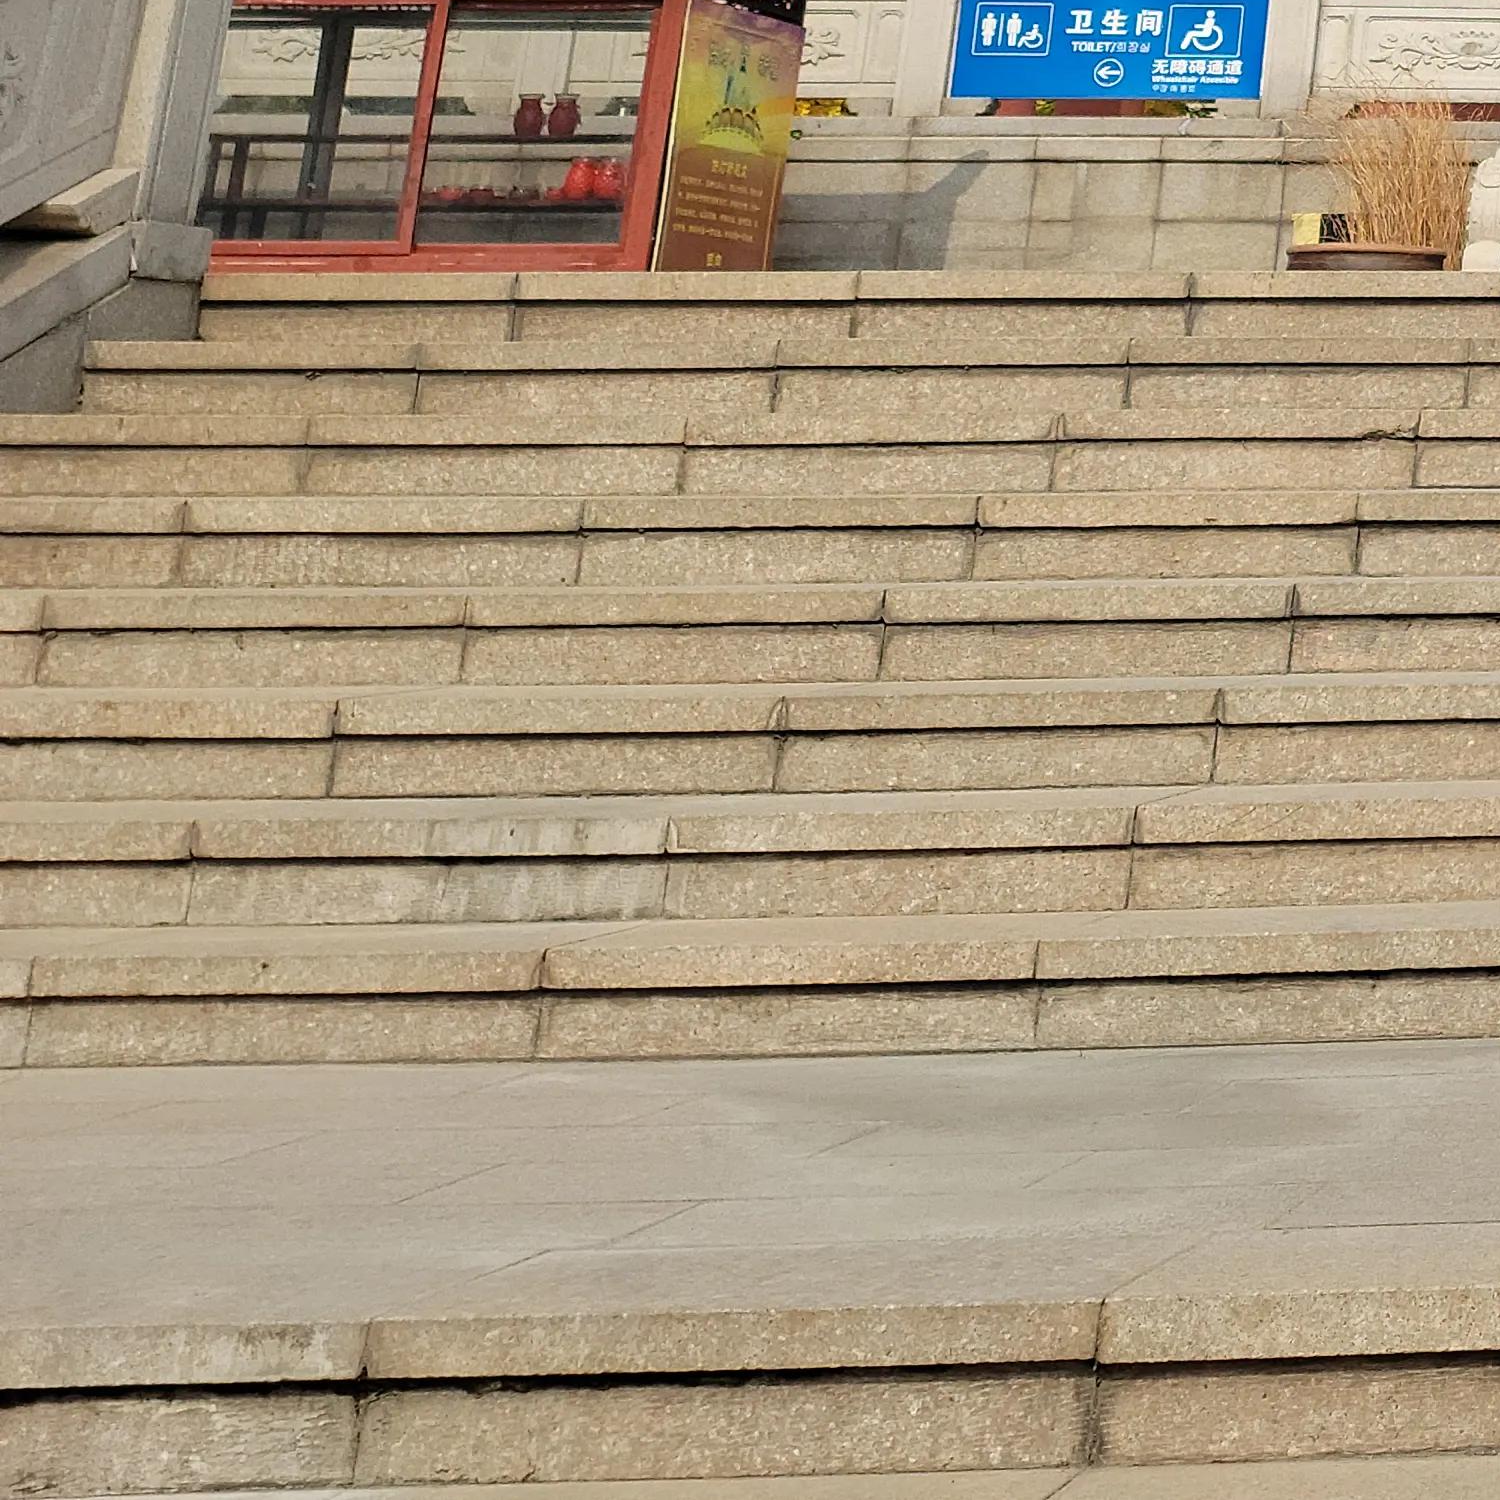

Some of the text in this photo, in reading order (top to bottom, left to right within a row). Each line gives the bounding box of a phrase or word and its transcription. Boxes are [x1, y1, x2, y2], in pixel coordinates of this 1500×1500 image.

[1065, 8, 1164, 36] 卫生间
[1151, 58, 1244, 75] 无障碍通道
